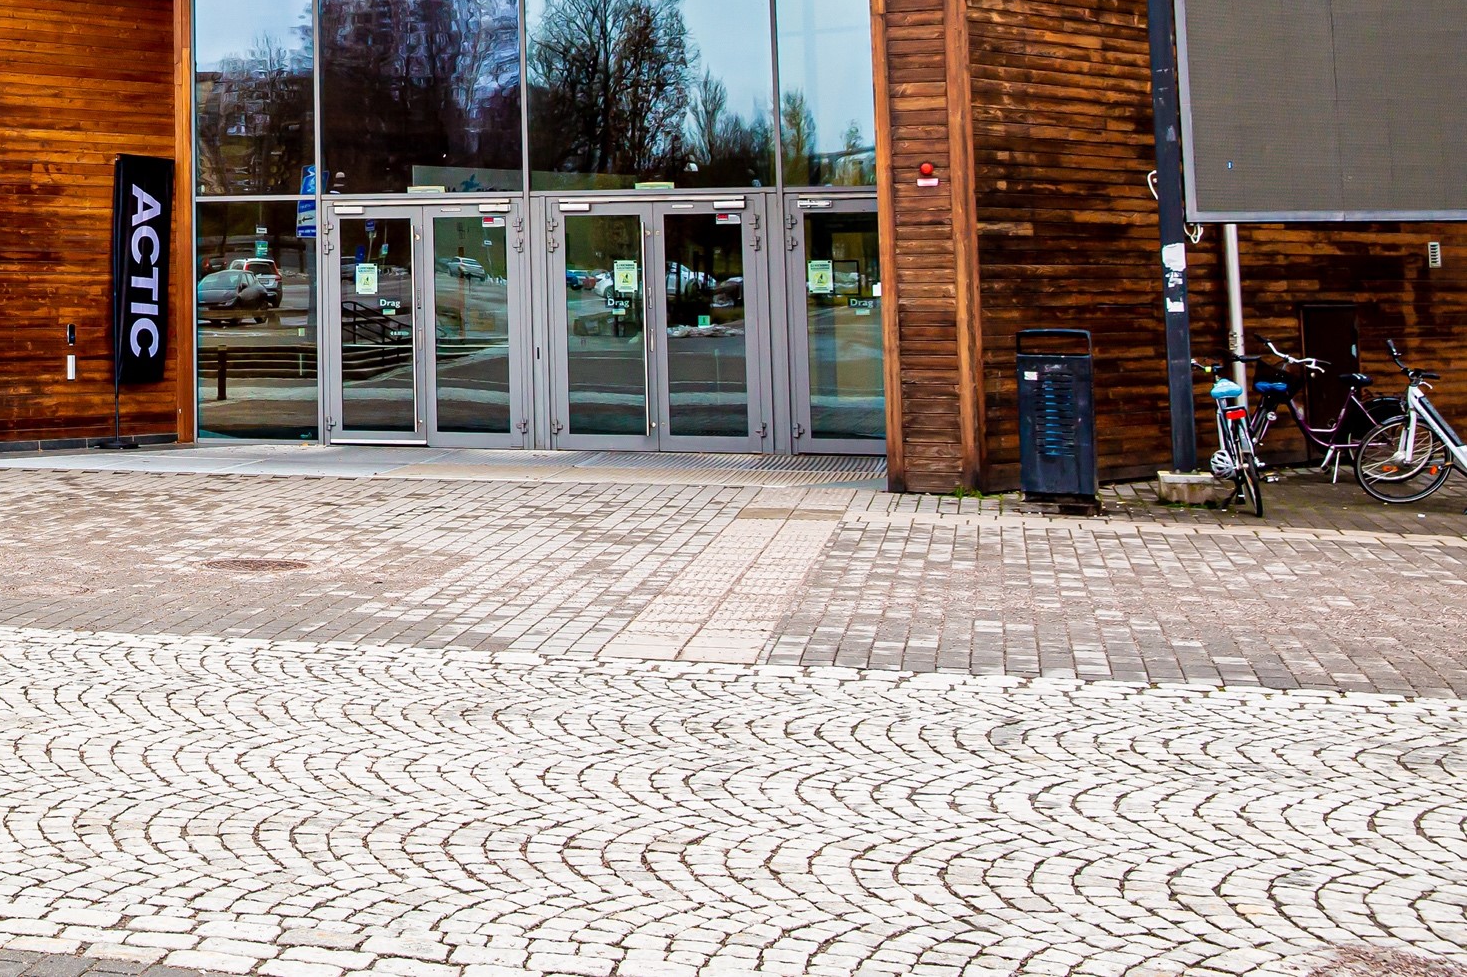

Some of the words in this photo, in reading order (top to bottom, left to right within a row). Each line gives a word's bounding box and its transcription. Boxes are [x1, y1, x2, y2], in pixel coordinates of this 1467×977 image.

[130, 183, 162, 358] ACTIC
[379, 298, 401, 309] Drag
[607, 298, 630, 308] Drag
[850, 298, 874, 309] Drag
